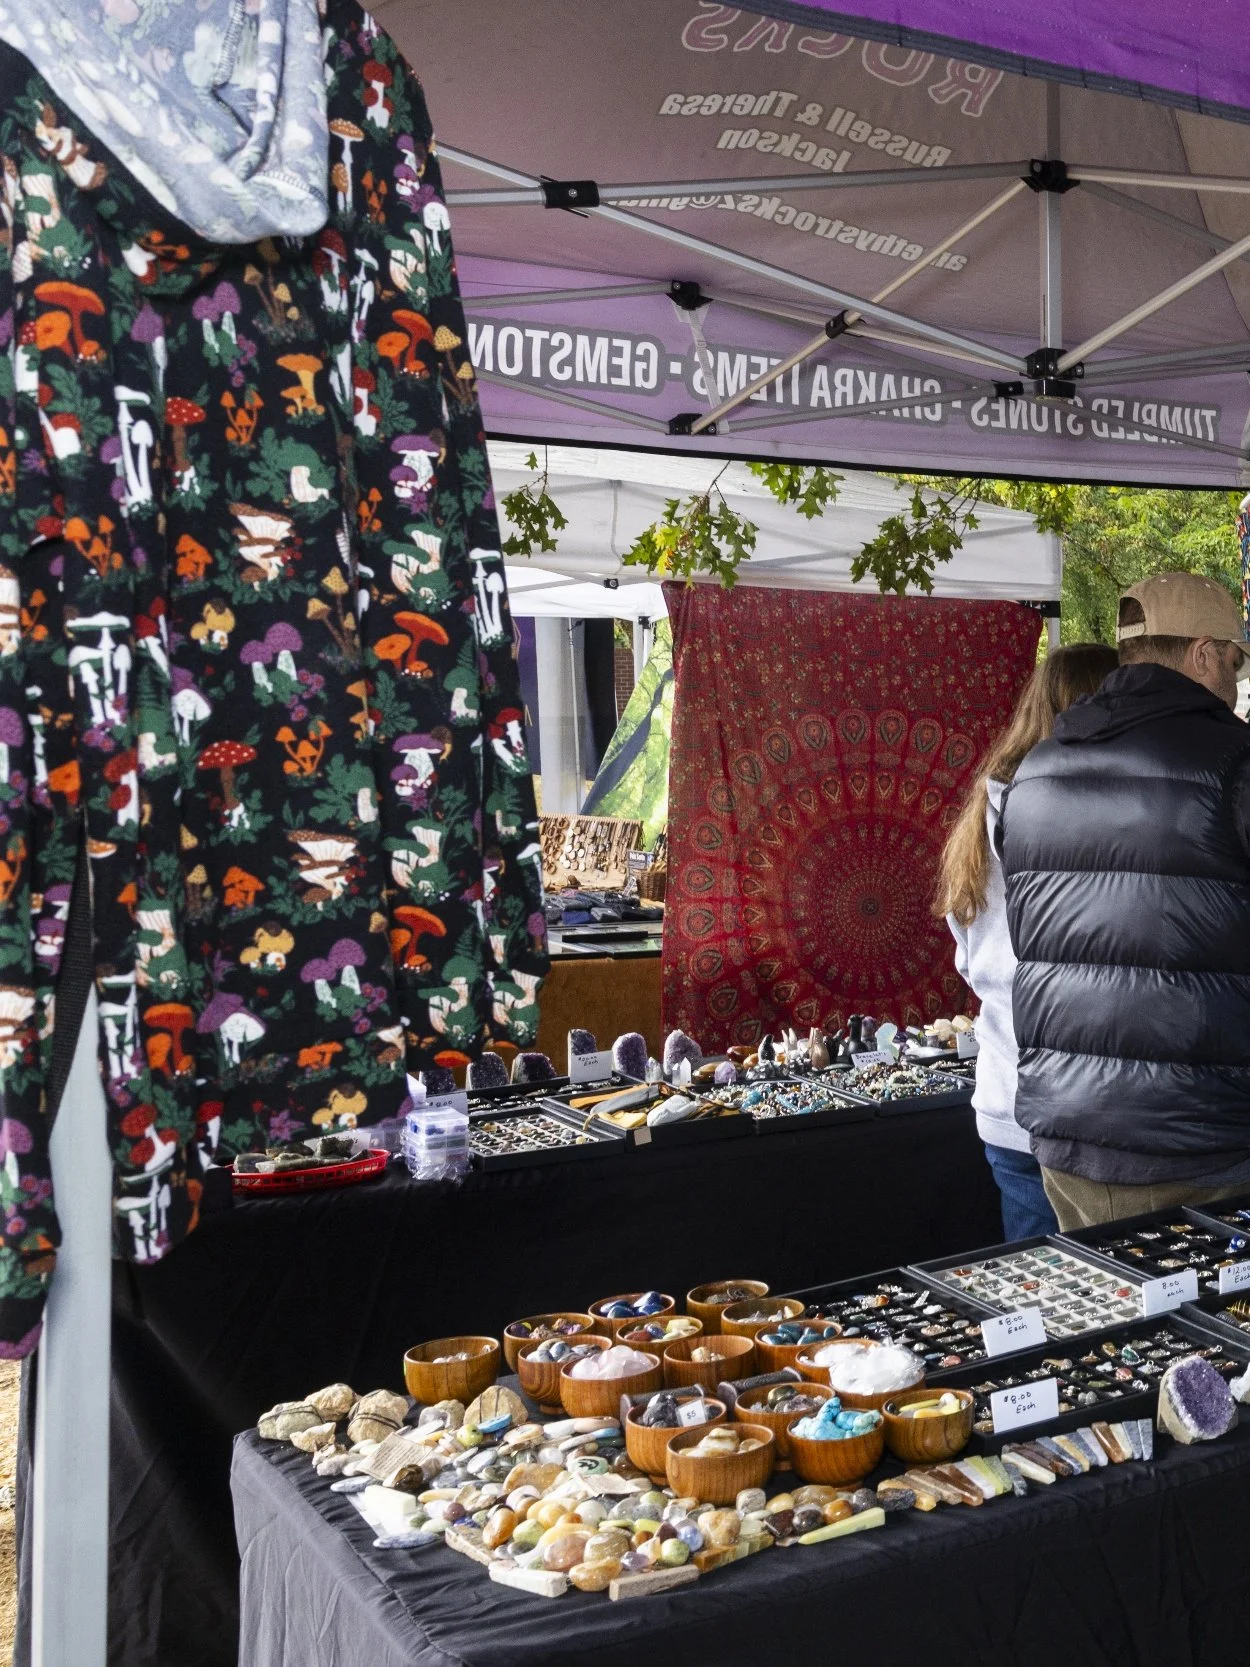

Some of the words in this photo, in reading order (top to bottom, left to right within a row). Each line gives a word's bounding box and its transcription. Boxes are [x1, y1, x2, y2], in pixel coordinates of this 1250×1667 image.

[1227, 1265, 1250, 1275] $12.00
[998, 1315, 1023, 1326] $8.00
[1007, 1323, 1028, 1335] Each
[1003, 1391, 1032, 1404] $8.00
[1015, 1402, 1037, 1414] Each
